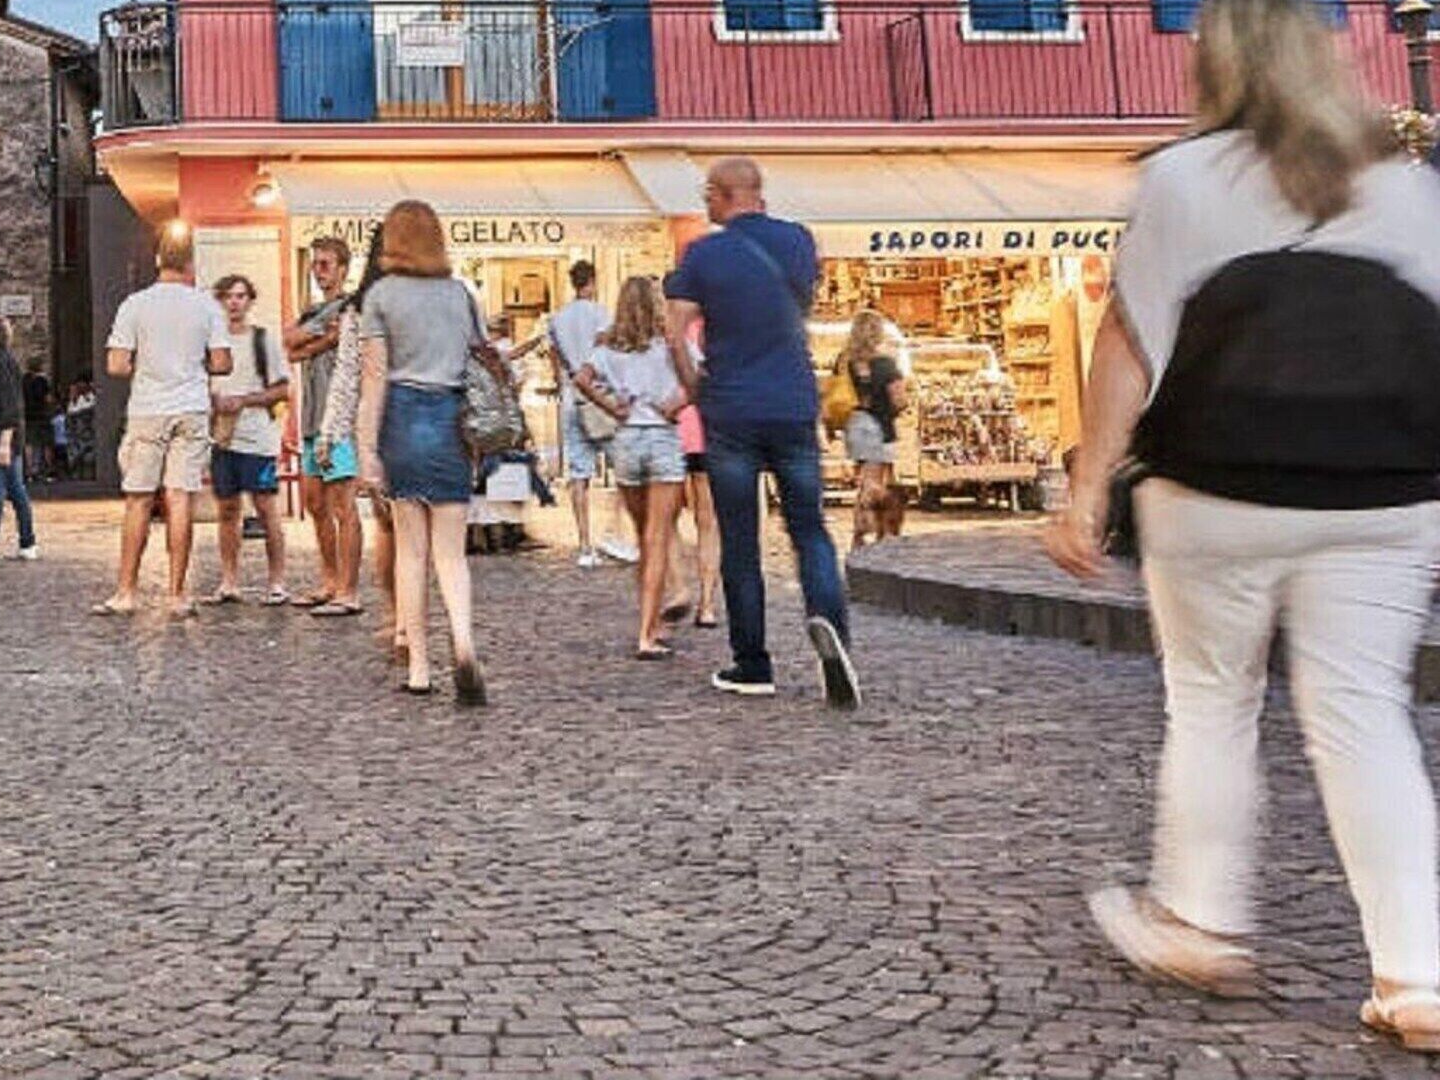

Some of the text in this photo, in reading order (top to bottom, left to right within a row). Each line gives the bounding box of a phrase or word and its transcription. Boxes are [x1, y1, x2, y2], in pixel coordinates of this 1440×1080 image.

[450, 220, 565, 244] GELATO
[868, 229, 984, 253] SAPORI
[1002, 229, 1036, 249] DI
